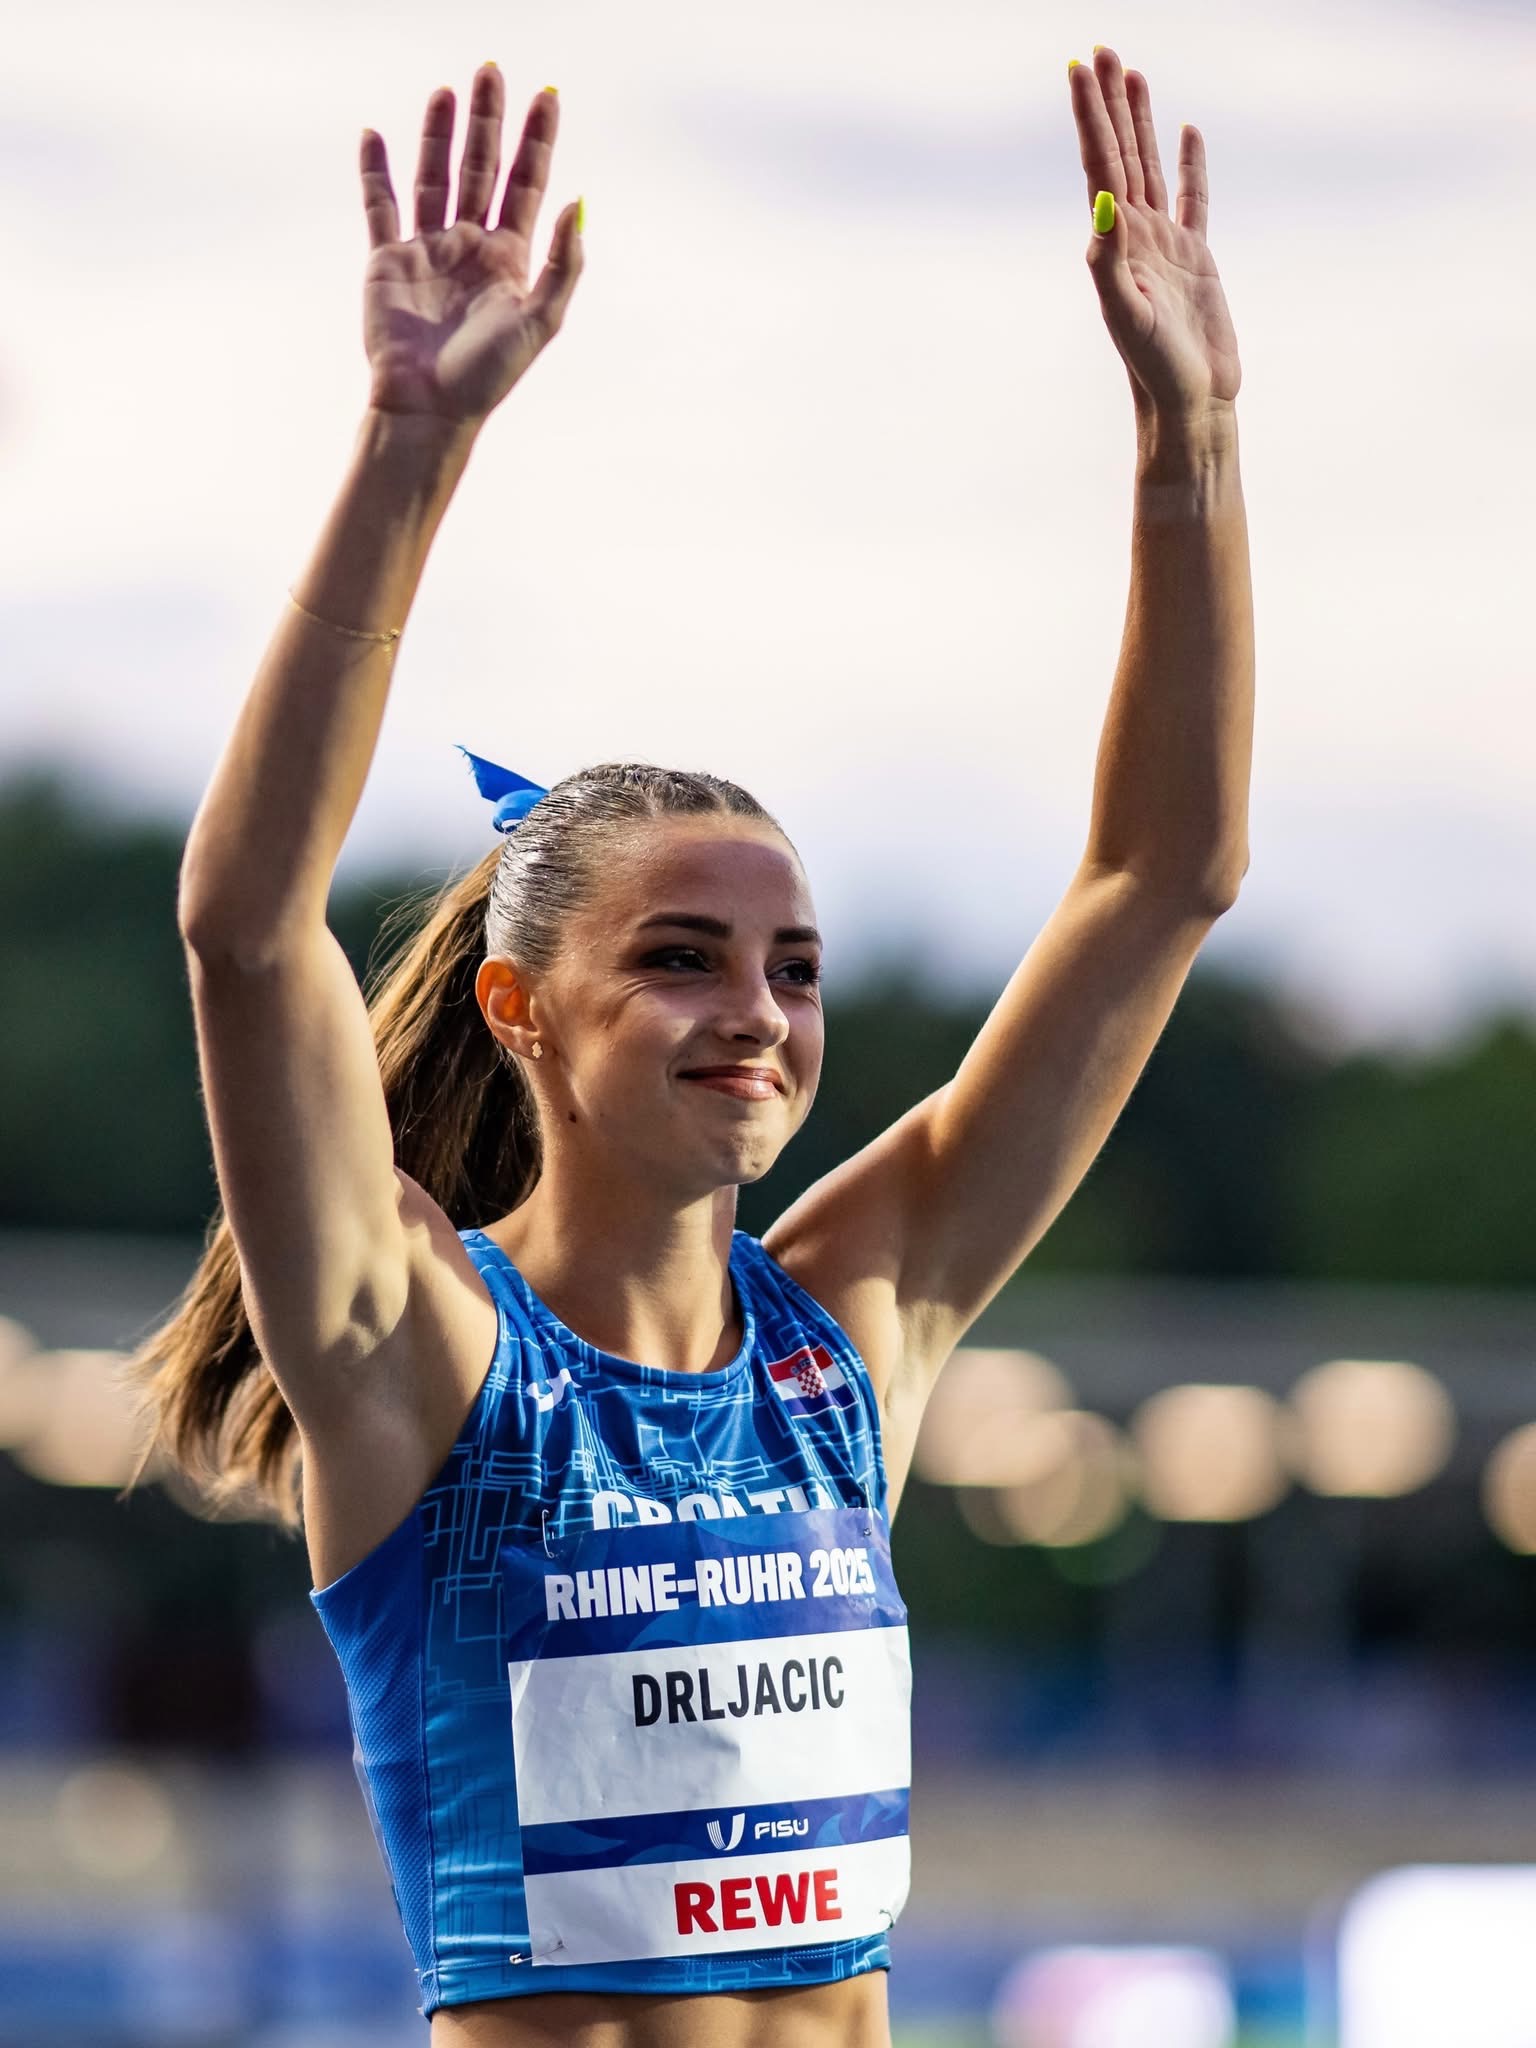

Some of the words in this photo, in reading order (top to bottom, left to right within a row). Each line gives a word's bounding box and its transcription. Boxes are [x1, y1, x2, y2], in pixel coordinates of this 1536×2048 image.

[544, 1552, 806, 1621] RHINE-RUHR
[810, 1548, 876, 1598] 2025
[632, 1656, 845, 1727] DRLJACIC
[754, 1818, 809, 1839] FISU
[674, 1869, 842, 1935] REWE
